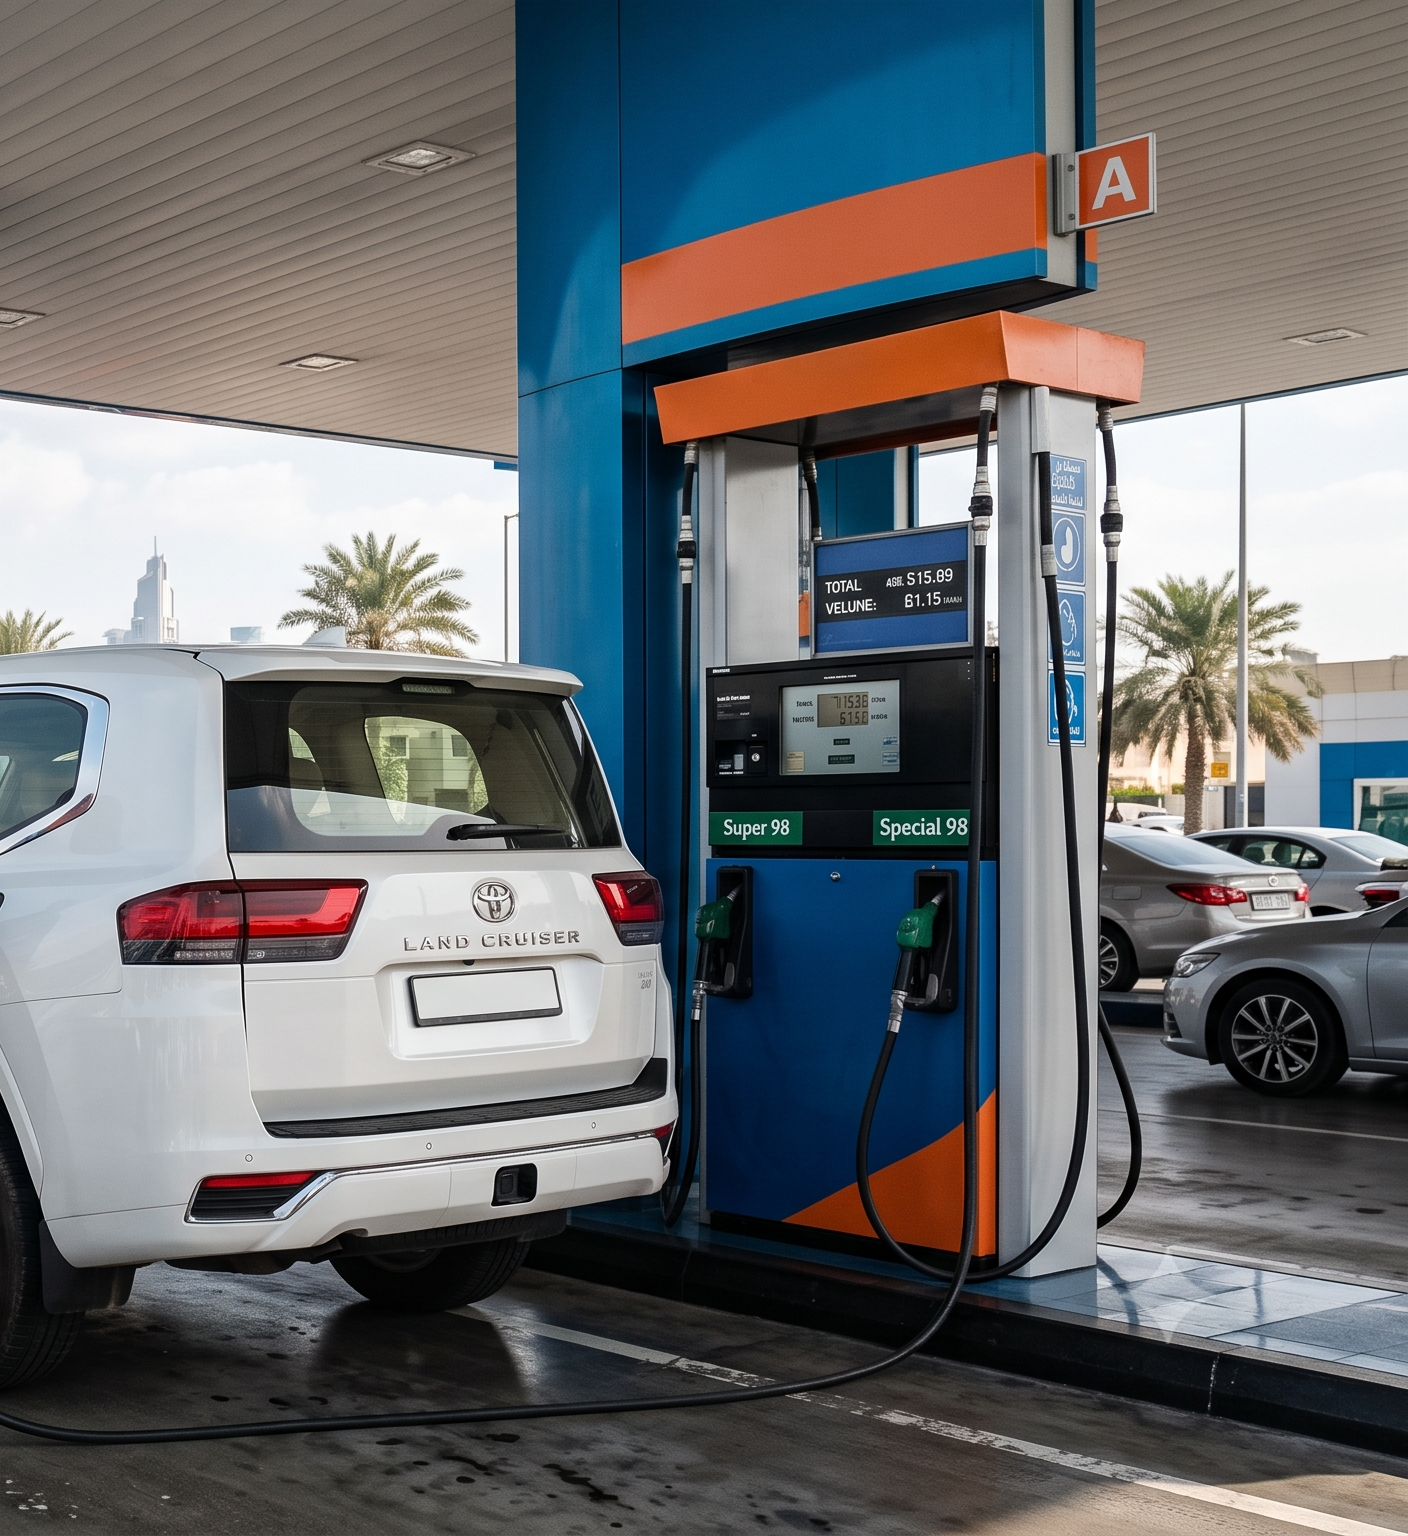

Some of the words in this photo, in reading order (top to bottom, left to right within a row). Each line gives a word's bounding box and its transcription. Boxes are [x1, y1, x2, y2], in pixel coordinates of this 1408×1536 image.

[1092, 156, 1136, 210] A
[825, 579, 862, 594] TOTAL
[826, 599, 877, 615] VELUNE:
[723, 819, 768, 841] Super
[771, 819, 790, 836] 98
[880, 817, 942, 841] Special
[946, 817, 968, 836] 98
[403, 934, 471, 952] LAND
[481, 930, 580, 949] CRUISER
